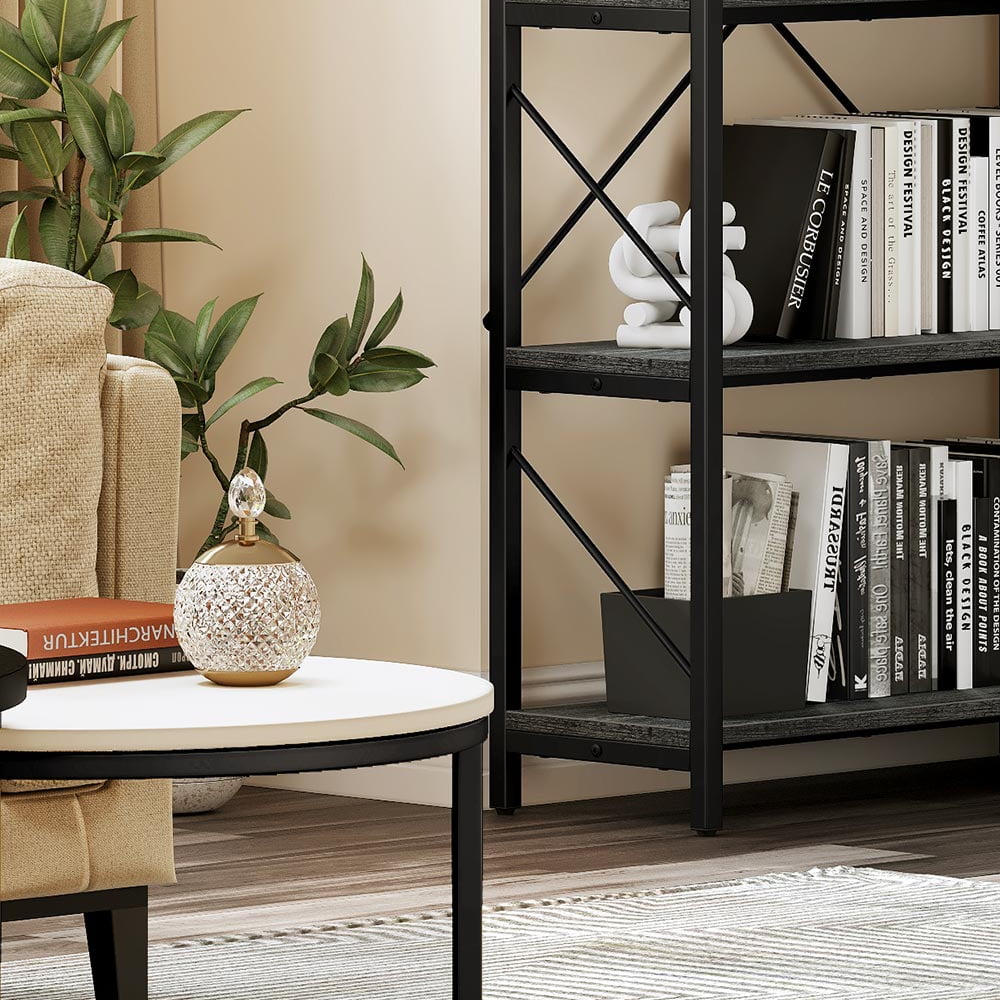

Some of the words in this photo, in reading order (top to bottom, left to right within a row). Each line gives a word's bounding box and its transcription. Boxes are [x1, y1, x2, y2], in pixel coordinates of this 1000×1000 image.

[903, 130, 913, 177] DESIGN
[816, 168, 834, 196] LE
[903, 182, 913, 238] FESTIVAL
[941, 178, 952, 221] BLACK
[977, 210, 986, 245] COFFEE
[787, 198, 826, 310] CORBUSIER
[941, 230, 952, 279] DESIGN
[977, 250, 986, 279] ATLAS
[945, 539, 954, 566] lets,
[962, 524, 971, 570] BLACK
[992, 496, 1000, 578] CONTAMINATION
[978, 546, 987, 573] BOOK
[945, 570, 954, 604] clean
[978, 577, 987, 611] ABOUT
[992, 579, 1000, 593] OF
[945, 608, 954, 630] the
[962, 578, 971, 631] DESIGN
[992, 594, 1000, 613] THE
[43, 624, 176, 650] NARCHITEKTUR
[945, 634, 954, 651] air
[978, 615, 987, 652] POINTS
[992, 614, 1000, 650] DESIGN
[28, 658, 75, 682] СНИМАЙ!
[77, 654, 116, 678] ДУМАЙ.
[117, 652, 159, 671] СМОТРИ.
